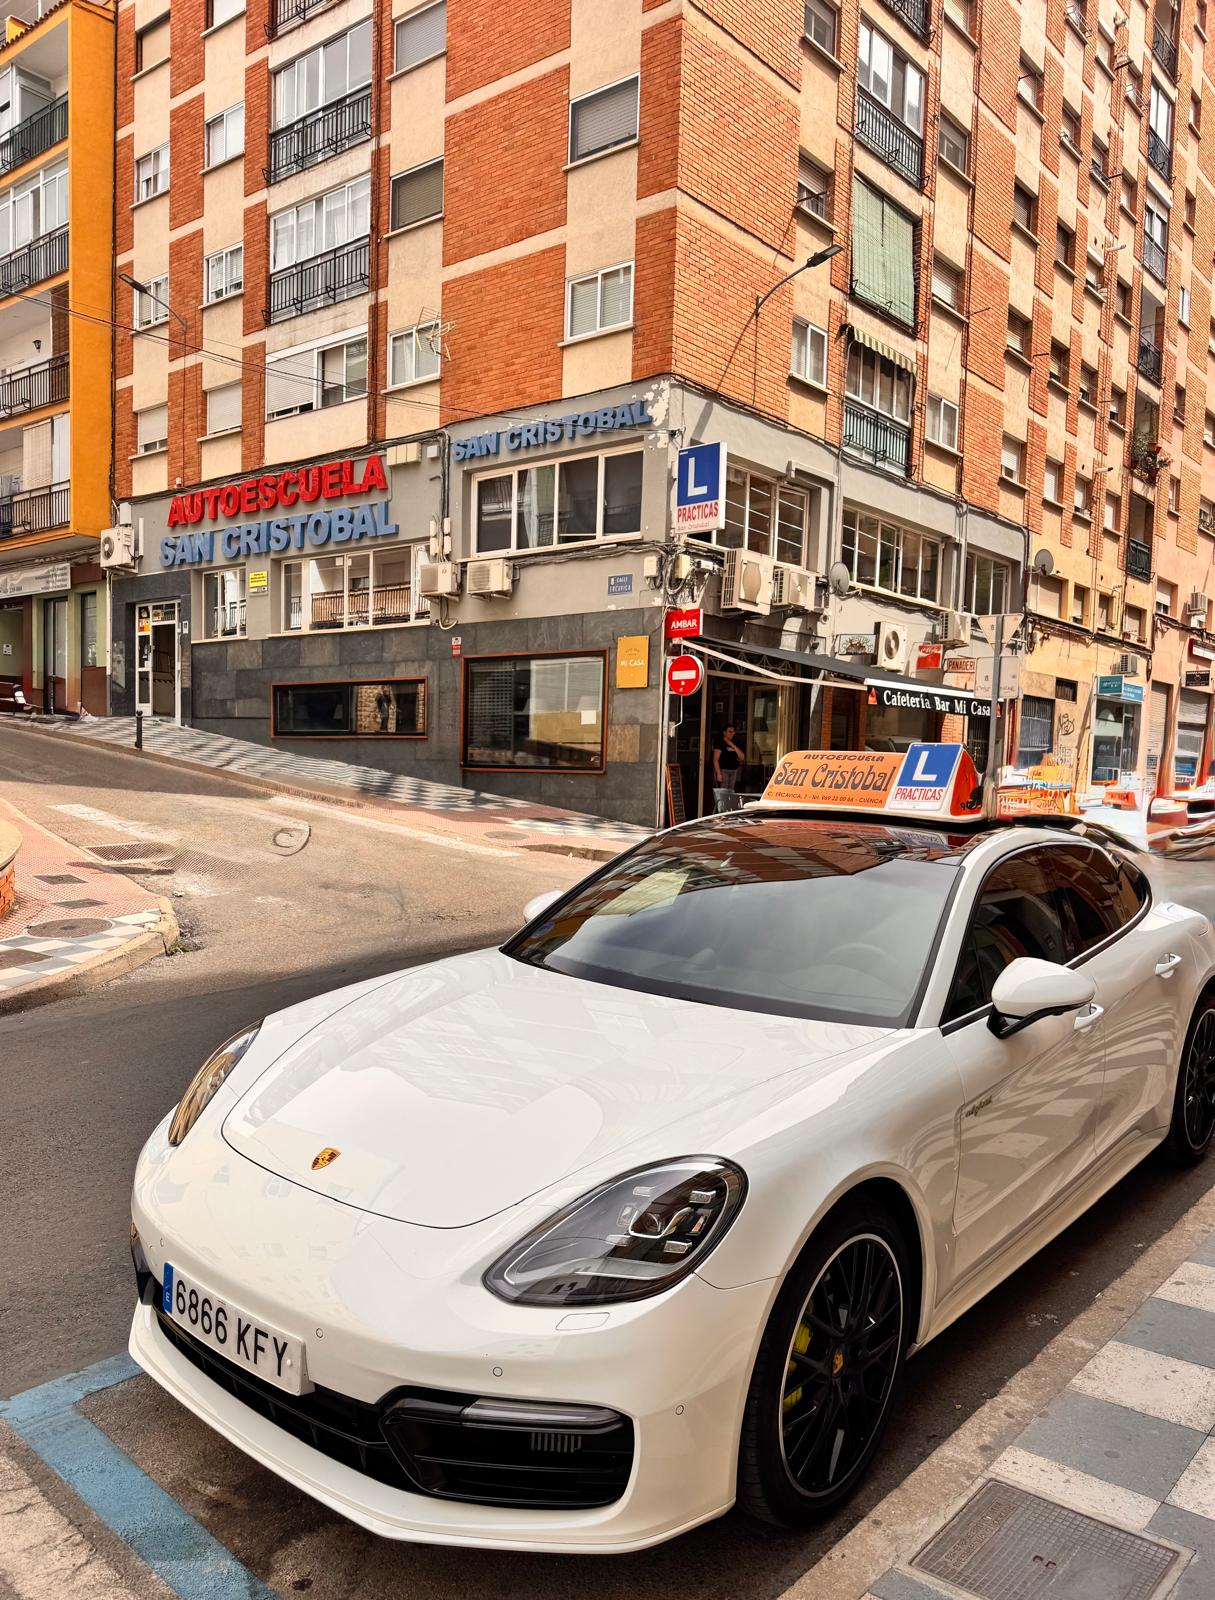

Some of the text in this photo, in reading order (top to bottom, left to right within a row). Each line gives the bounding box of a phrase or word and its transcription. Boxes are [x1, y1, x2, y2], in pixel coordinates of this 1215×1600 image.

[452, 399, 652, 461] SAN CRISTOBAL
[167, 454, 389, 527] AUTOESCUELA
[688, 457, 707, 497] L
[677, 502, 718, 523] PRACTICAS
[159, 498, 400, 567] SAN CRISTOBAL
[670, 619, 698, 629] AMBAR
[948, 660, 975, 671] PANADERI
[934, 696, 950, 712] Bar
[954, 699, 966, 715] Mi
[971, 701, 991, 716] Casa
[803, 754, 885, 762] AUTOESCUELA
[912, 751, 938, 781] L
[774, 762, 897, 791] San Cristobal
[895, 788, 943, 801] PRACTICAS
[176, 1280, 289, 1377] 6866 KFY
